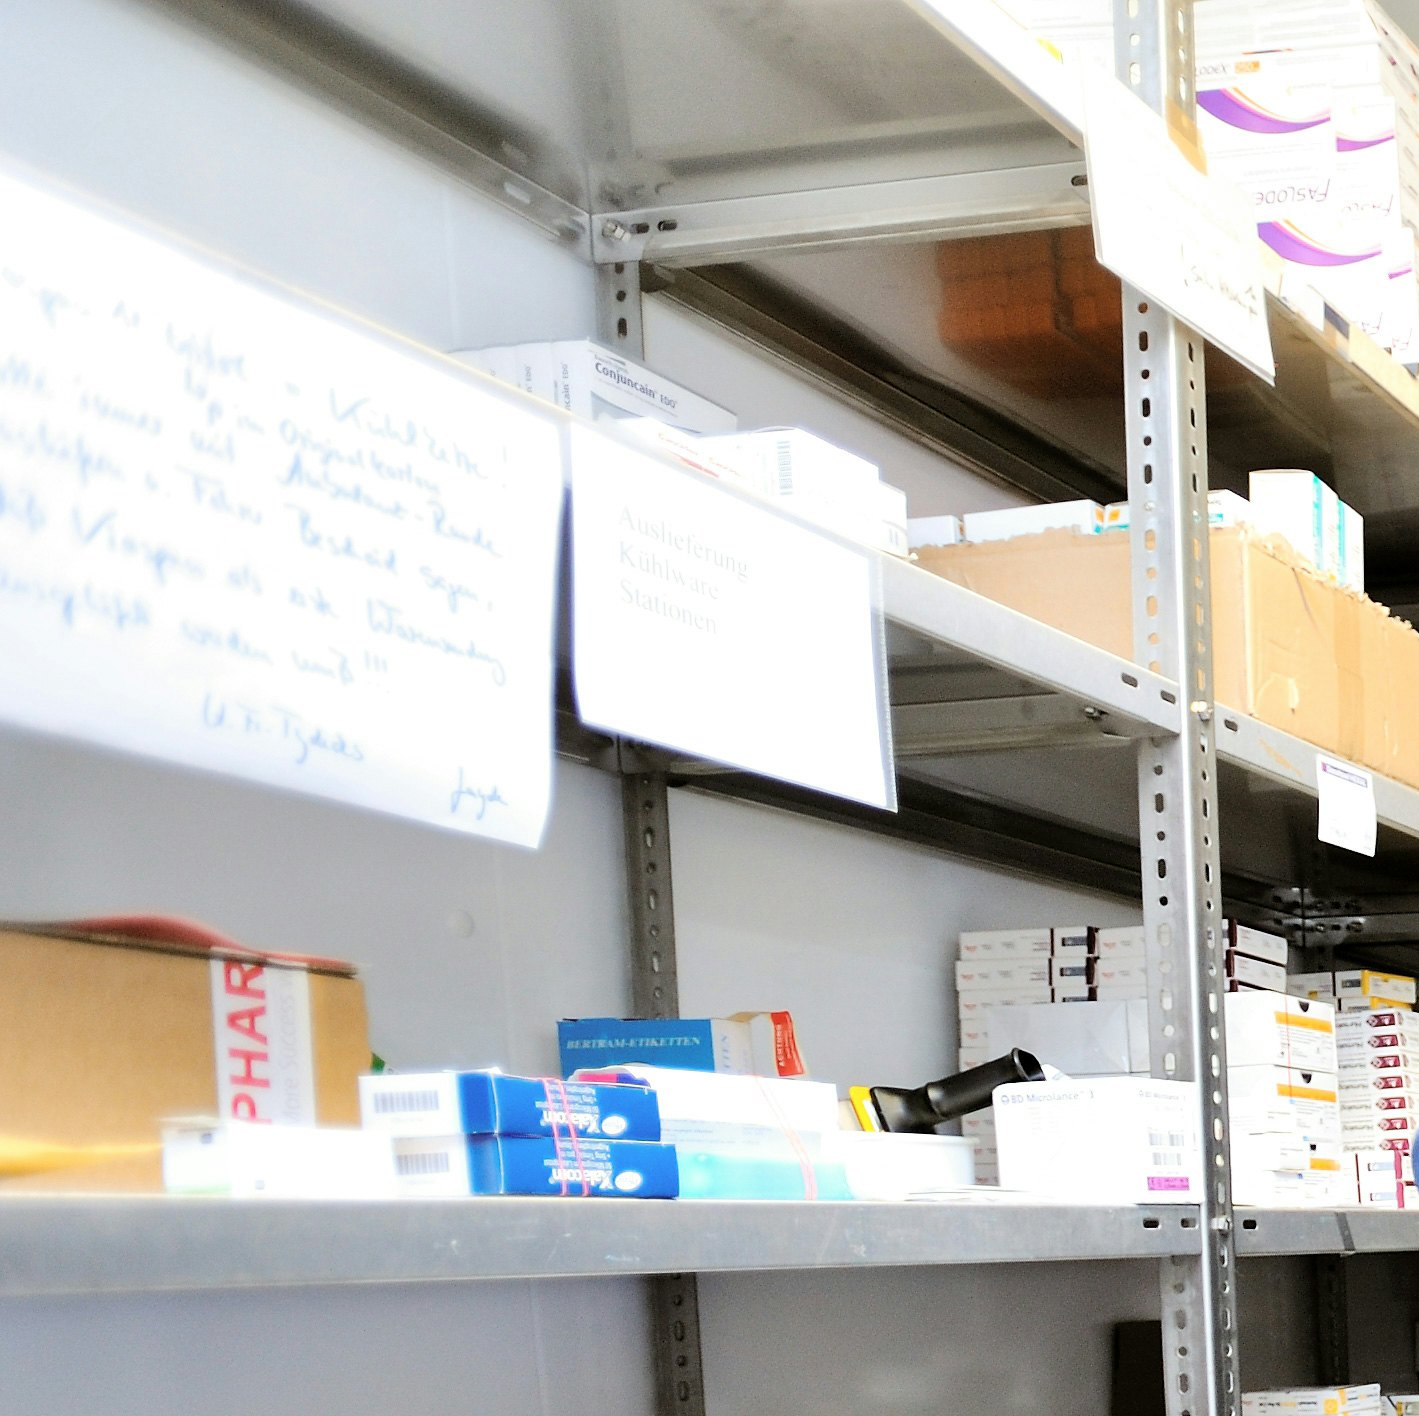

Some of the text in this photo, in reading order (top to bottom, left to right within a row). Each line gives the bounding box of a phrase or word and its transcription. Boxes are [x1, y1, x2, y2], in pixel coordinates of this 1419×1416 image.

[1256, 178, 1332, 206] FASLODE
[594, 360, 679, 410] Conjuncain EDO
[618, 504, 750, 580] Auslieferung
[618, 540, 721, 600] Kühlware
[618, 577, 719, 635] Stationen
[224, 958, 272, 1125] PHAR
[565, 1036, 701, 1050] BERTRAM-ETIKETTEN
[1010, 1091, 1080, 1104] BD Microlance
[543, 1109, 601, 1134] Xalacom
[550, 1168, 614, 1191] Xalacom
